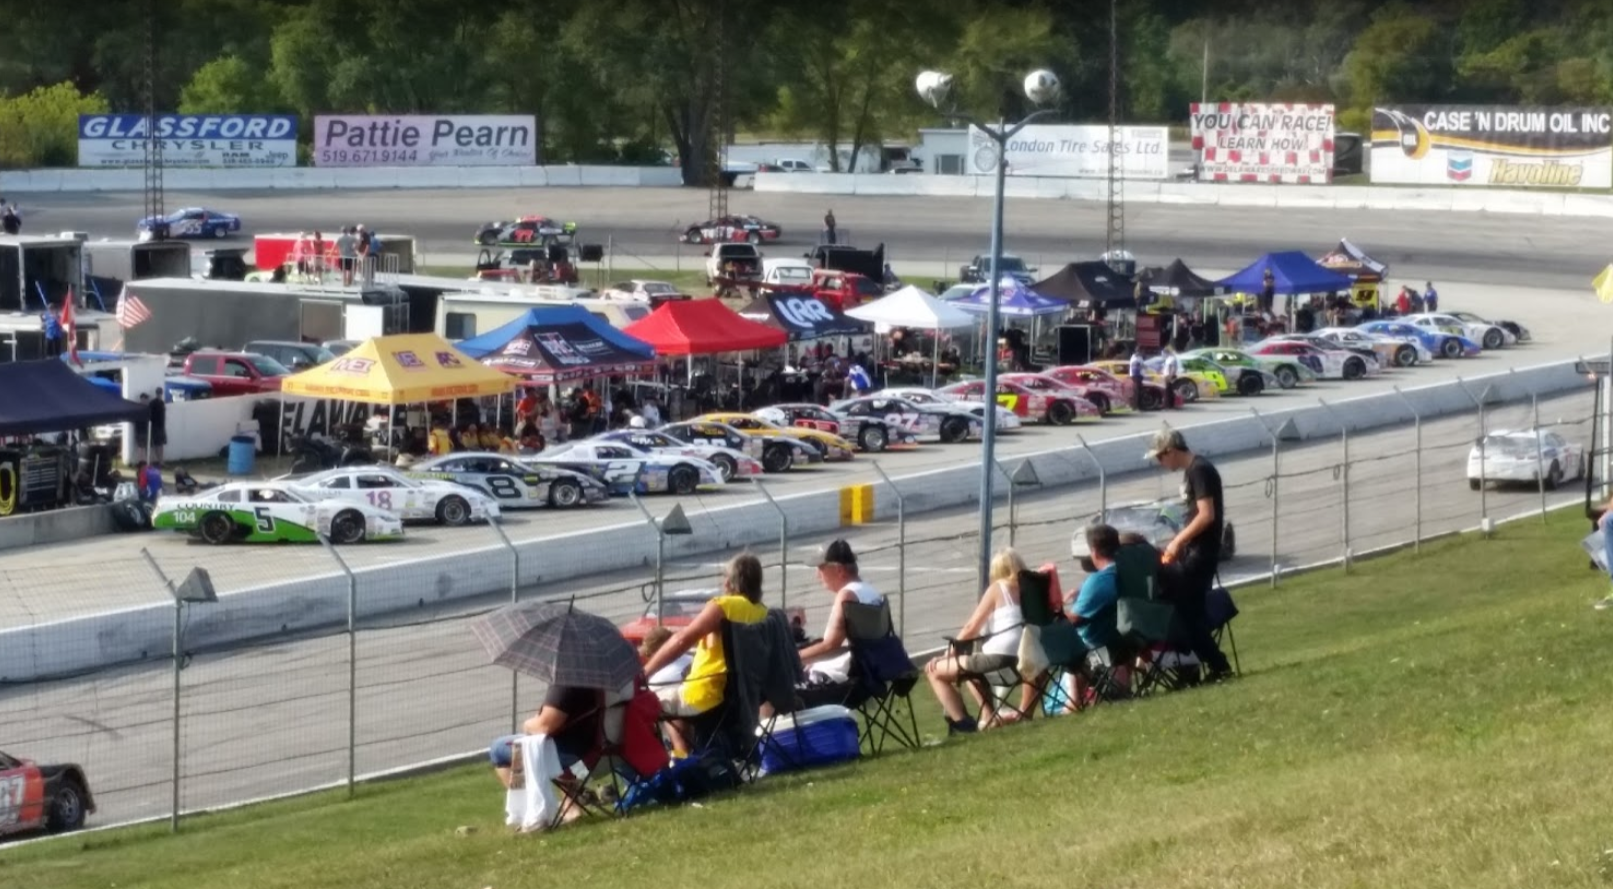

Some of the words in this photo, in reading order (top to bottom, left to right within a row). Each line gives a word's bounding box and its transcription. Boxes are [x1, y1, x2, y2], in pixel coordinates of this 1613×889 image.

[84, 116, 291, 138] GLASSFORD
[1193, 114, 1231, 130] YOU
[1237, 114, 1275, 130] CAN
[1281, 115, 1331, 132] RACE!
[1424, 111, 1471, 131] CASE
[1495, 112, 1545, 132] DRUM
[1550, 113, 1577, 133] OIL
[1582, 113, 1611, 133] INC
[325, 119, 420, 147] Pattie
[431, 119, 528, 147] Pearn
[112, 140, 264, 150] CHRYSLER
[1004, 138, 1056, 153] ondon
[1059, 140, 1087, 153] Tire
[1219, 137, 1266, 150] LEARN
[322, 150, 418, 163] 519.671.9144
[1488, 158, 1584, 185] Havoline
[486, 476, 522, 498] 8
[366, 491, 392, 511] 18
[173, 510, 196, 523] 104
[252, 506, 277, 534] 5
